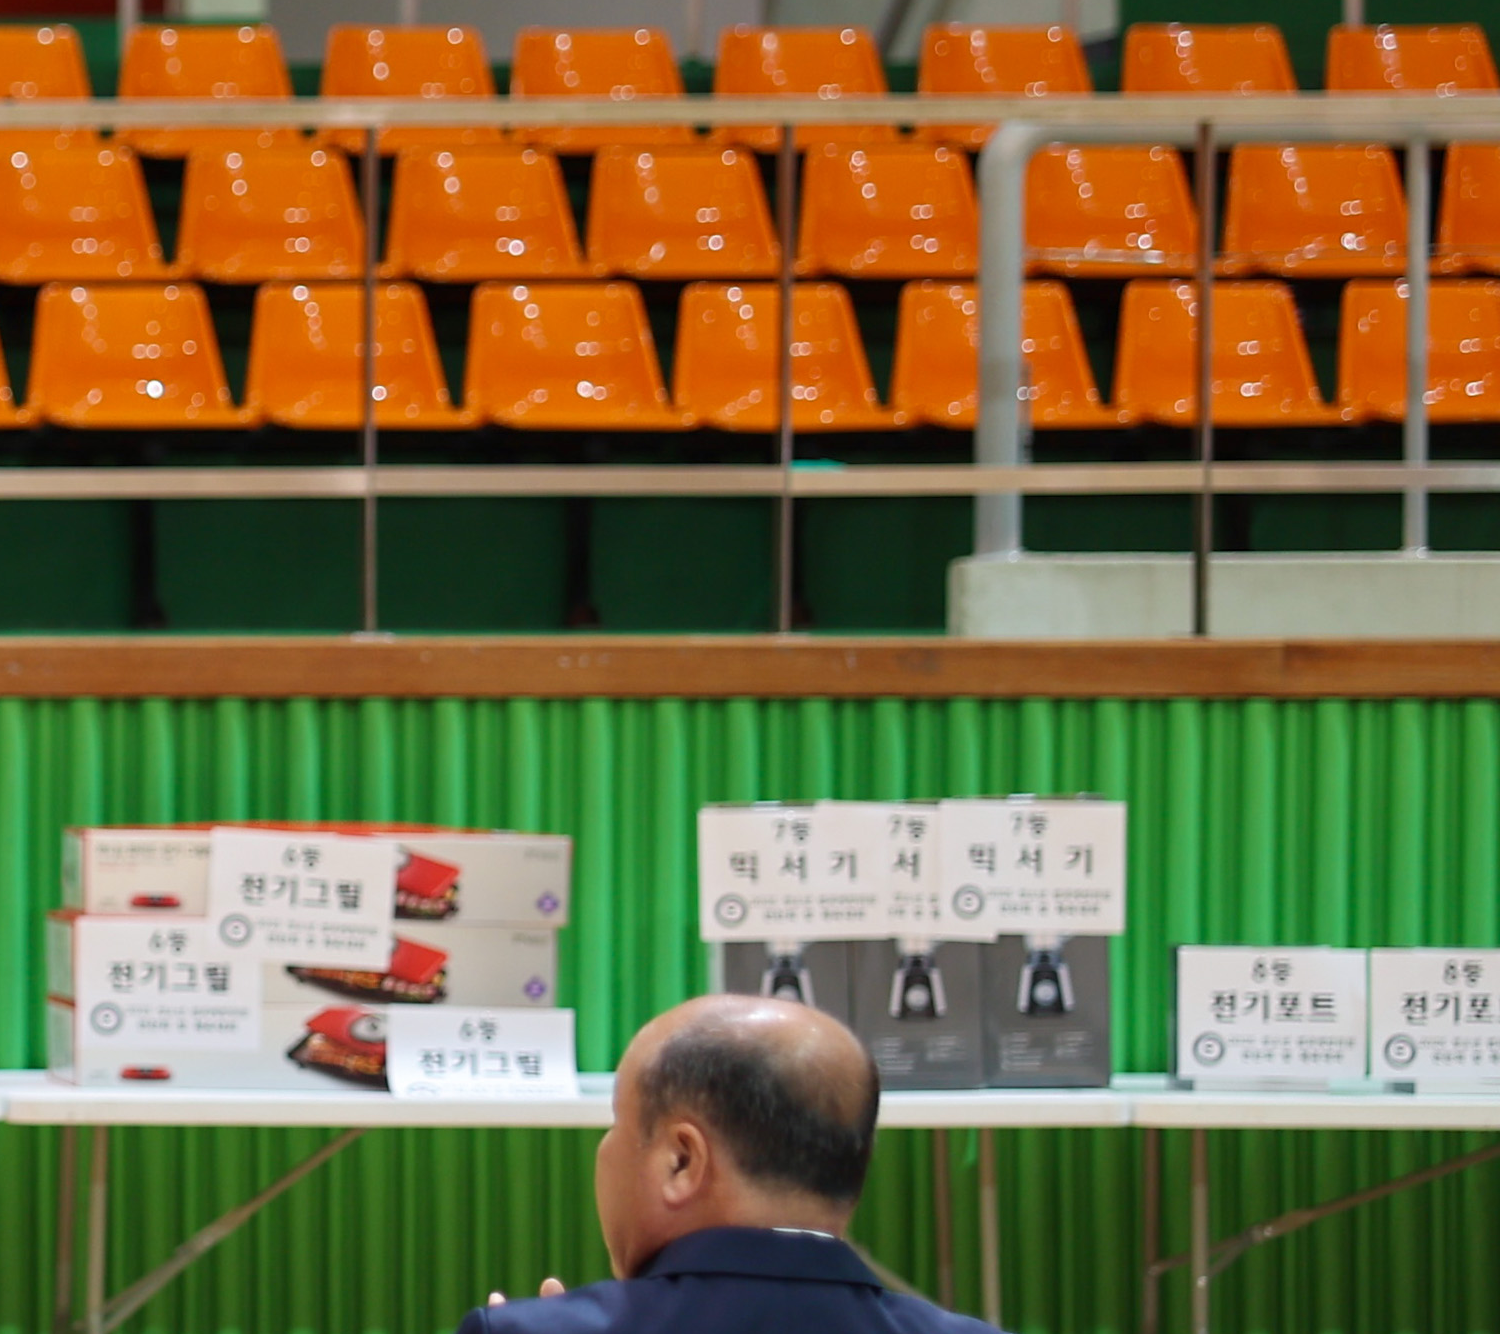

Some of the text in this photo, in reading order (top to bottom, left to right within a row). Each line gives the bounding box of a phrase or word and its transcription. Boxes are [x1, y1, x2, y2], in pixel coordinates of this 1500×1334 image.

[243, 876, 363, 912] 전기그릴
[111, 964, 231, 994] 전기그릴
[1213, 993, 1336, 1024] 전기포트
[421, 1049, 543, 1078] 전기그릴
